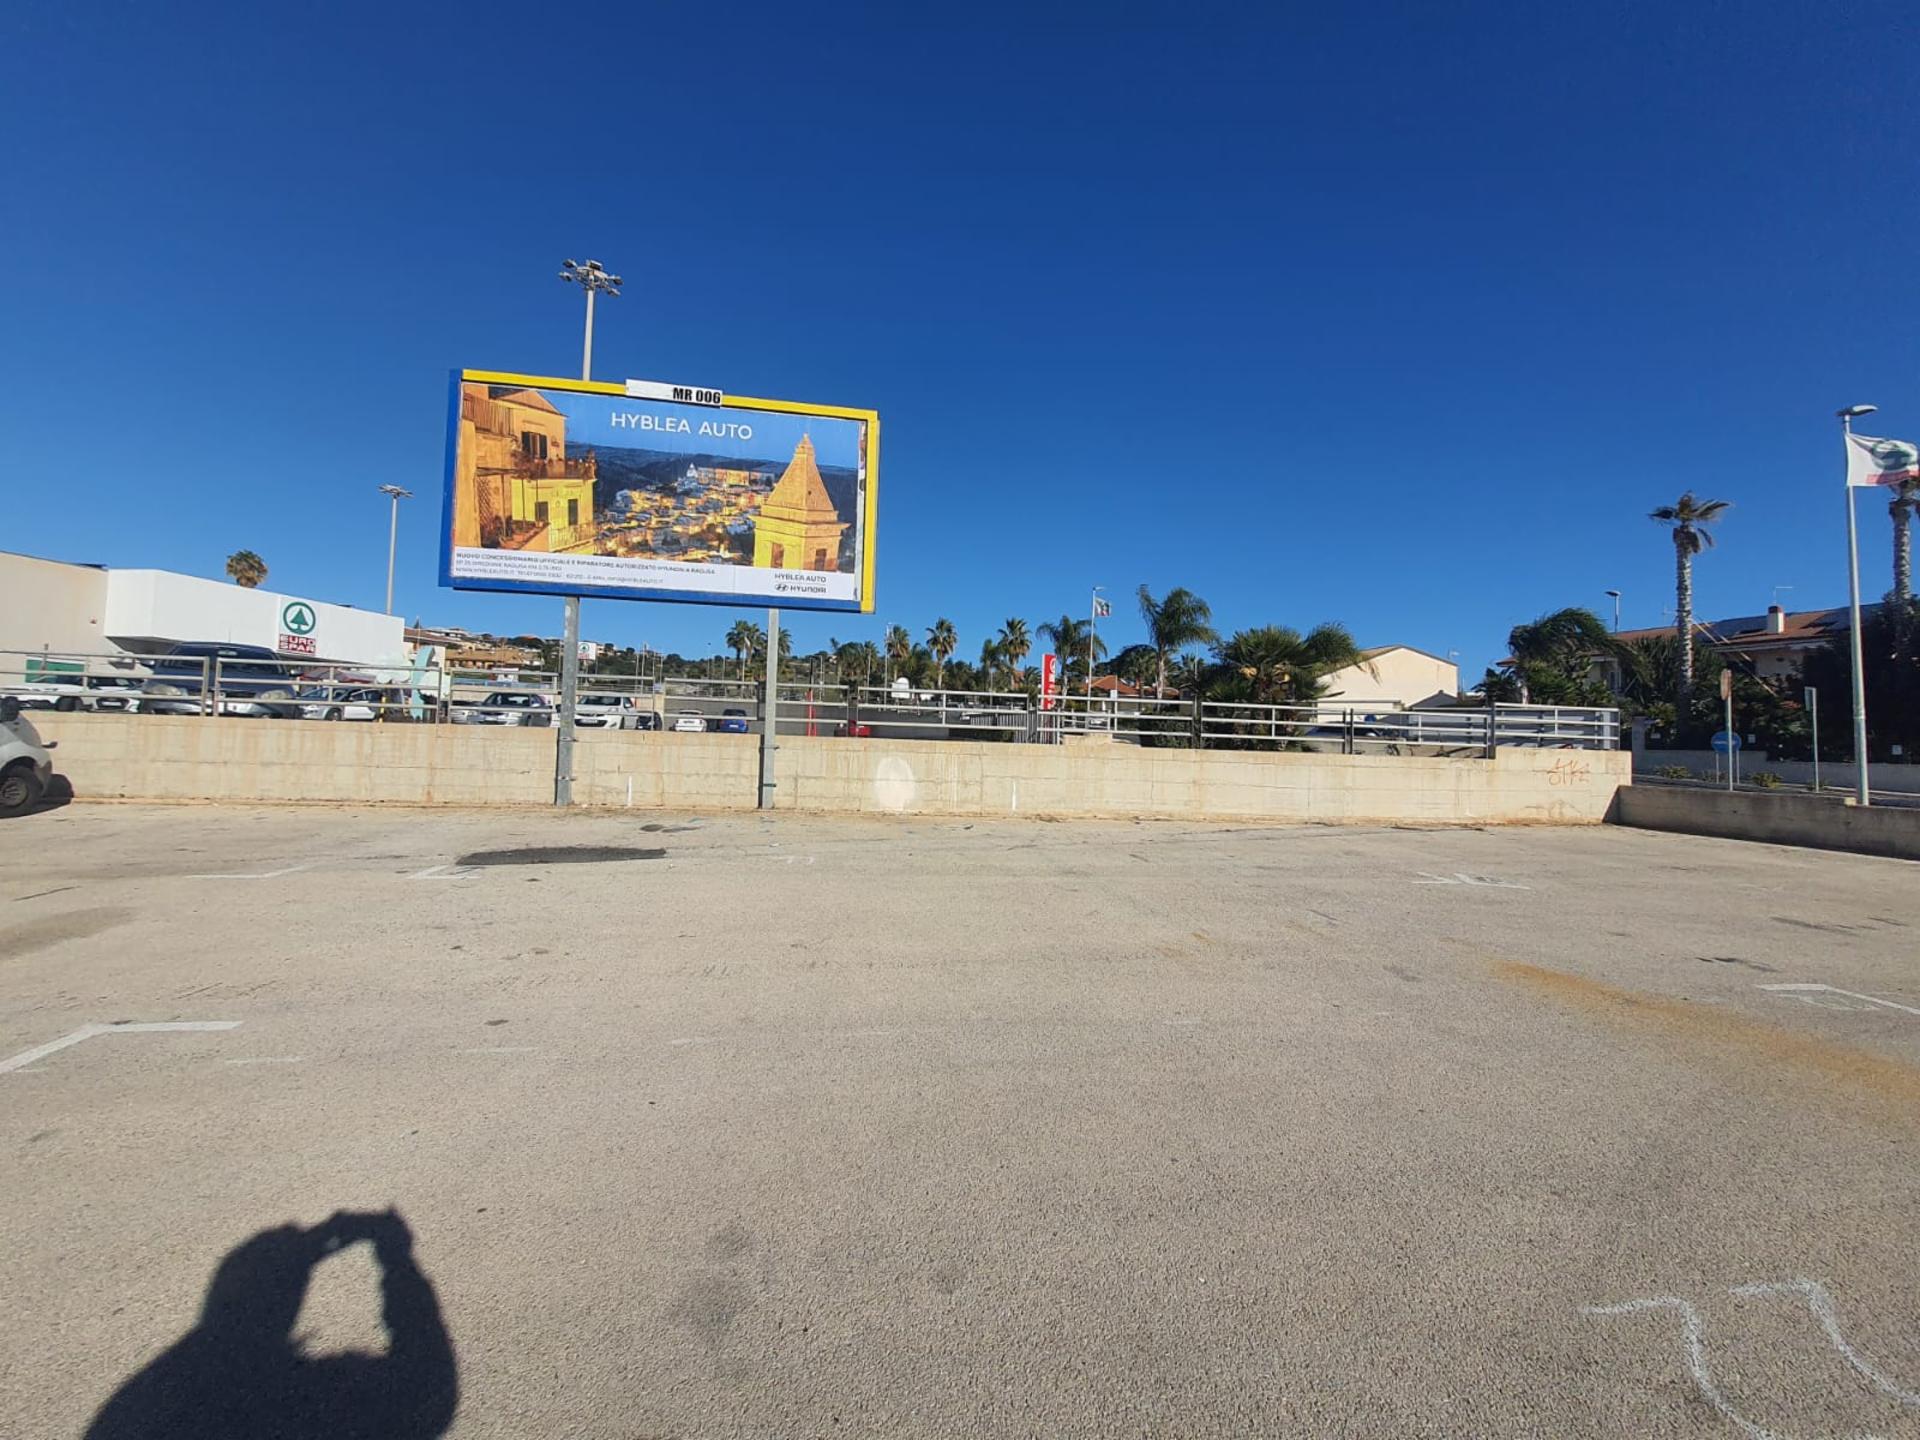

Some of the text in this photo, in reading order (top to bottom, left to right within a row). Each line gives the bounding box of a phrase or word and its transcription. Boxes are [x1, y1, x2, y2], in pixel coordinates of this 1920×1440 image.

[673, 387, 721, 404] MR 006
[611, 412, 753, 440] HYBLEA AUTO
[774, 573, 827, 583] HYBLEA AUTO
[280, 635, 315, 646] EURO
[280, 641, 315, 653] SPAR
